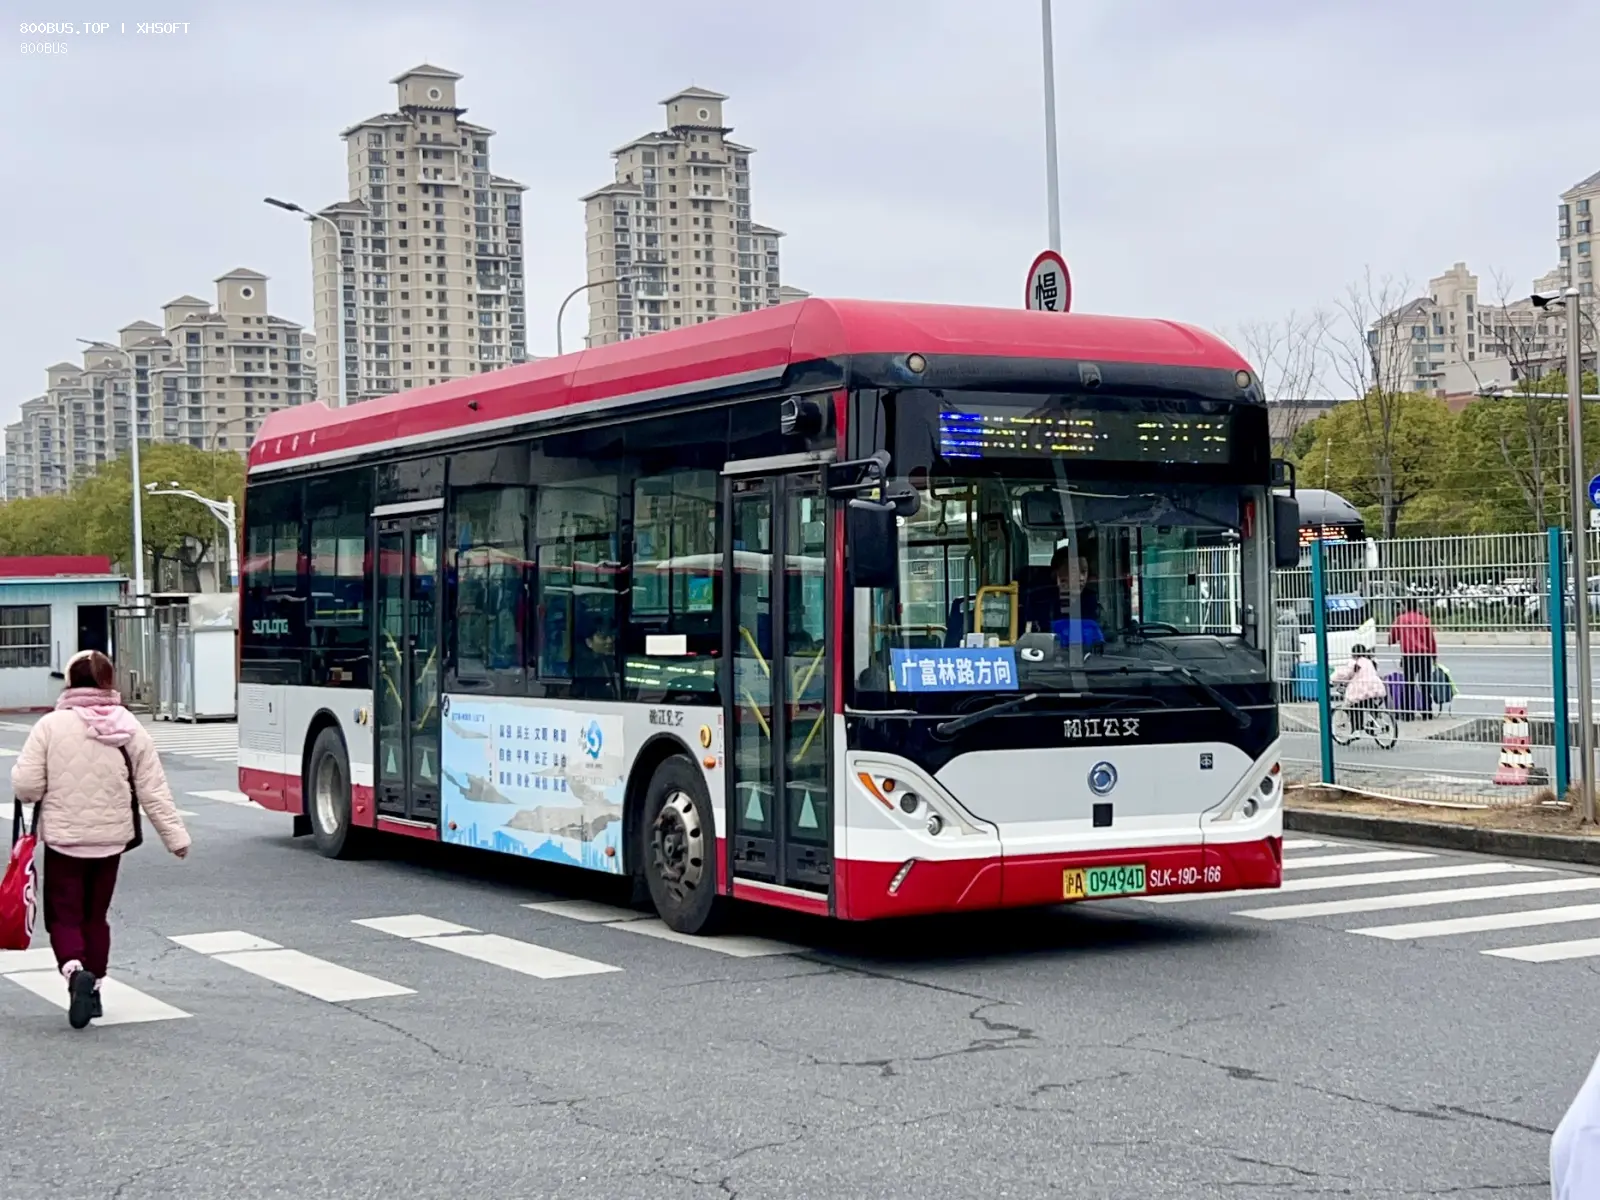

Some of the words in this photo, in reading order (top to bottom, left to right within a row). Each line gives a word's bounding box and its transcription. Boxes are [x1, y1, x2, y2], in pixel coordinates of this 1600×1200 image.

[1035, 271, 1059, 312] 慢
[901, 657, 1011, 686] 广富林路方向
[1063, 717, 1140, 738] 松江公交
[1090, 868, 1144, 892] 09494D
[1149, 866, 1221, 888] SLK-19D-166
